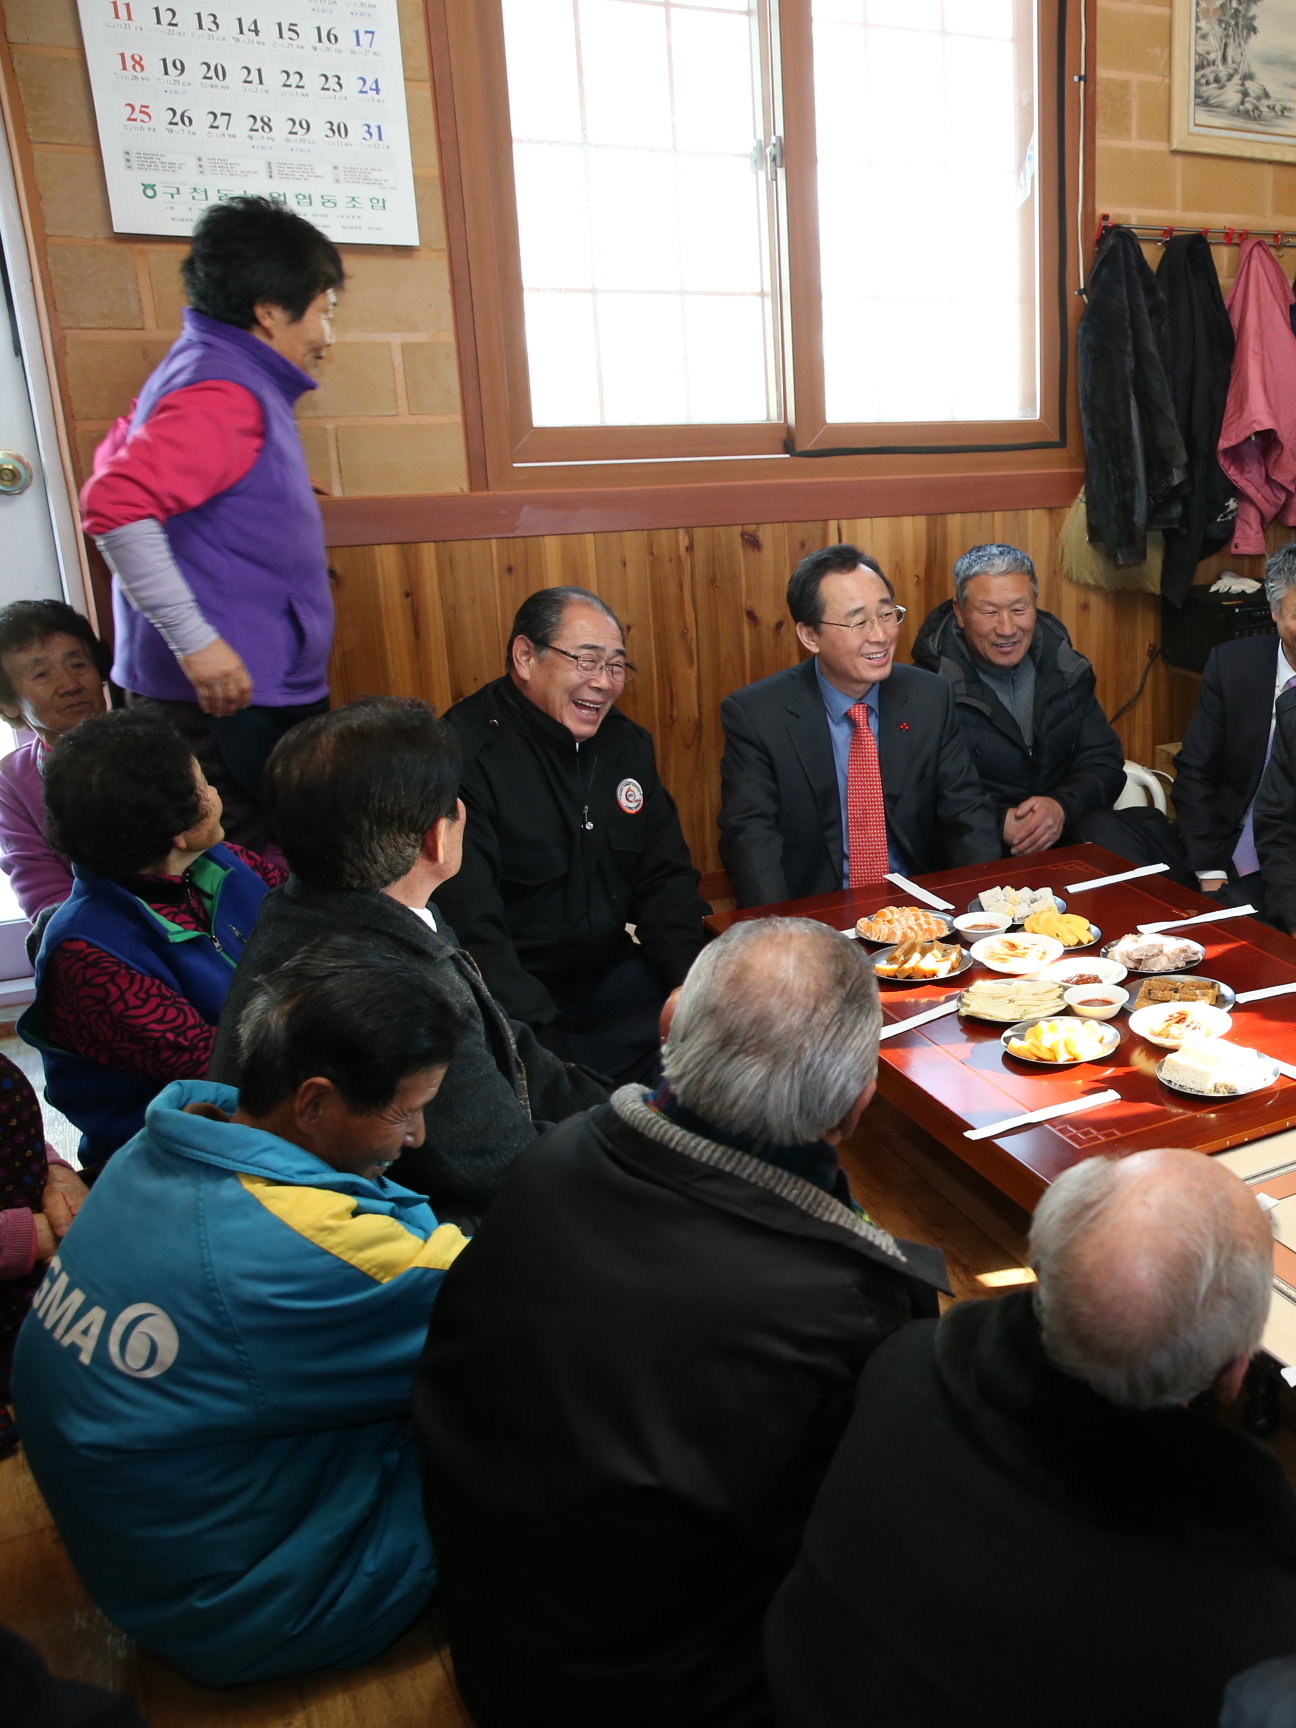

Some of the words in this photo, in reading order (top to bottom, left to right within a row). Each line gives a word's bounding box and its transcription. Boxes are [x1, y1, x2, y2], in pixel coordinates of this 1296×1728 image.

[110, 0, 135, 22] 11
[152, 6, 179, 27] 12
[194, 11, 220, 32] 13
[235, 17, 260, 37] 14
[275, 21, 300, 41] 15
[314, 25, 338, 45] 16
[352, 29, 375, 48] 17
[117, 52, 145, 73] 18
[159, 57, 186, 77] 19
[200, 61, 227, 82] 20
[240, 66, 266, 86] 21
[280, 69, 305, 89] 22
[319, 73, 343, 93] 23
[357, 76, 381, 95] 24
[124, 102, 152, 123] 25
[165, 107, 193, 127] 26
[206, 110, 232, 130] 27
[246, 114, 273, 134] 28
[286, 117, 311, 136] 29
[324, 120, 349, 139] 30
[361, 123, 384, 142] 31
